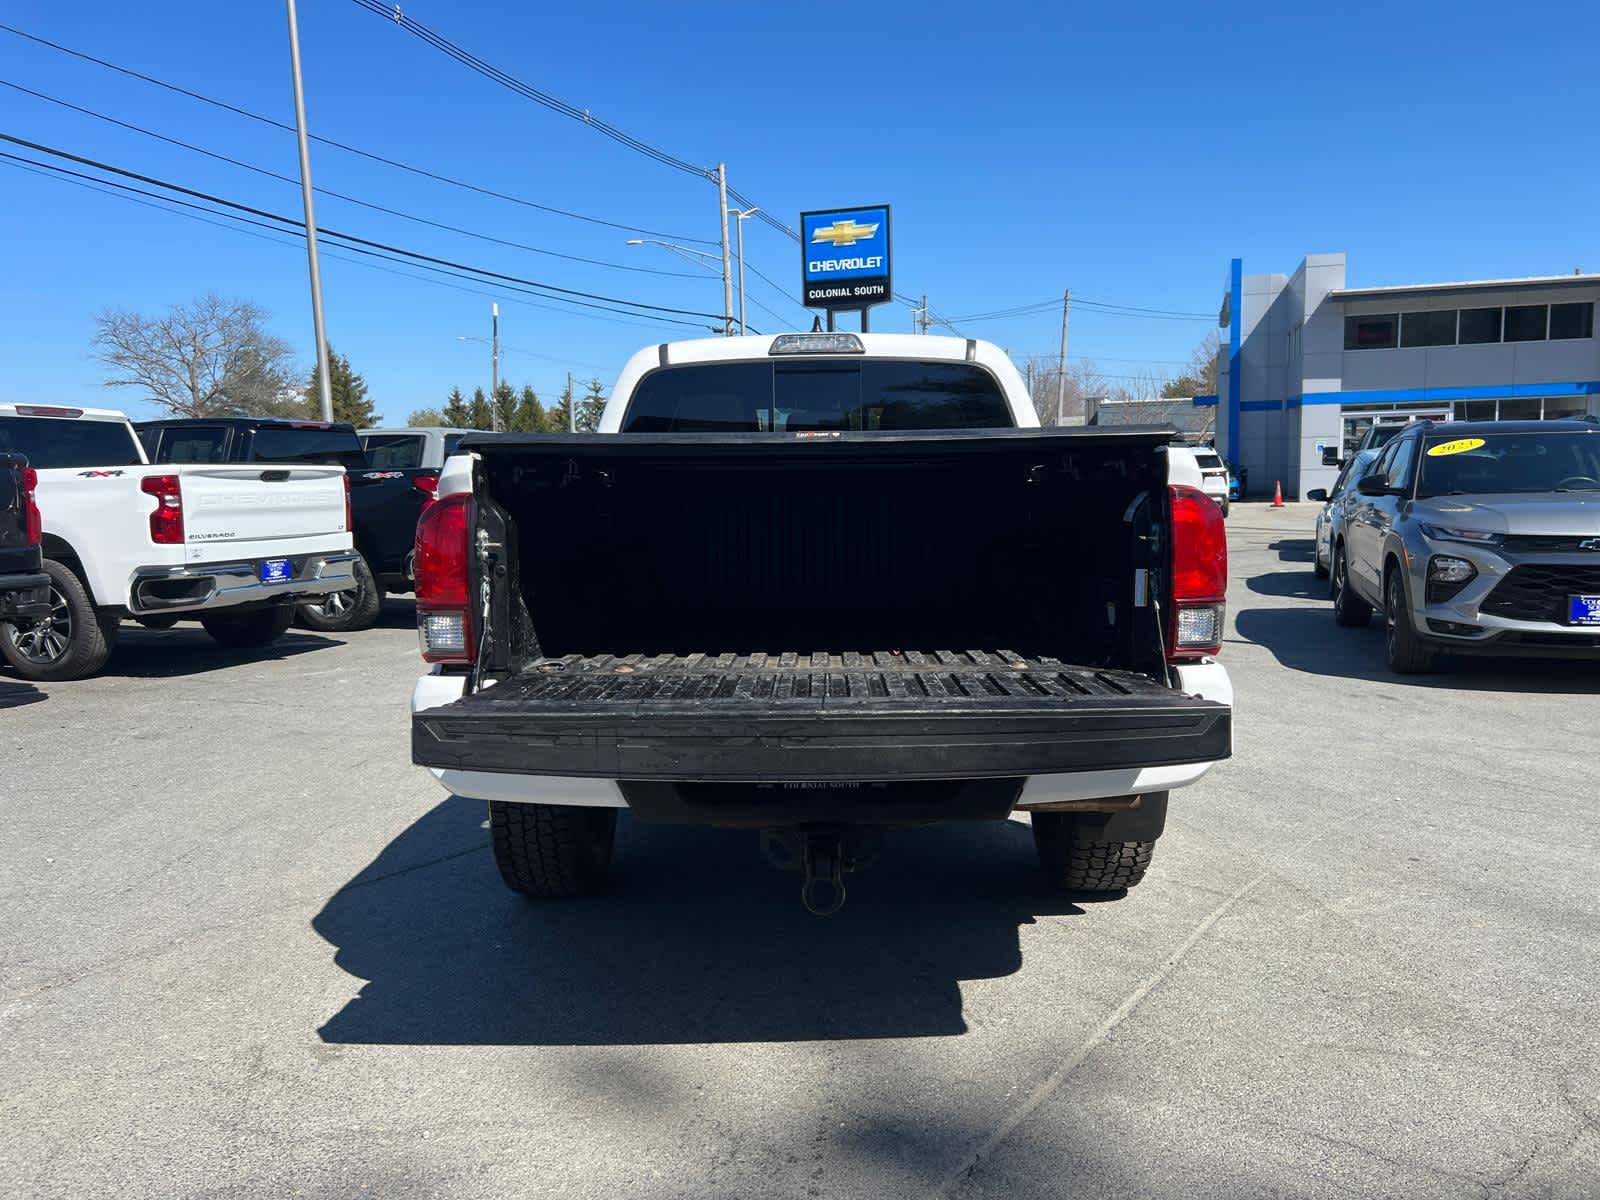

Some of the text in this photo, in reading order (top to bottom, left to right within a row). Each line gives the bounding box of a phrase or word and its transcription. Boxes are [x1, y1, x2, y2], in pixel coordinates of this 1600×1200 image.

[809, 256, 883, 273] CHEVROLET
[809, 285, 884, 299] COLONIAL SOUTH
[188, 532, 236, 540] SILVERADO
